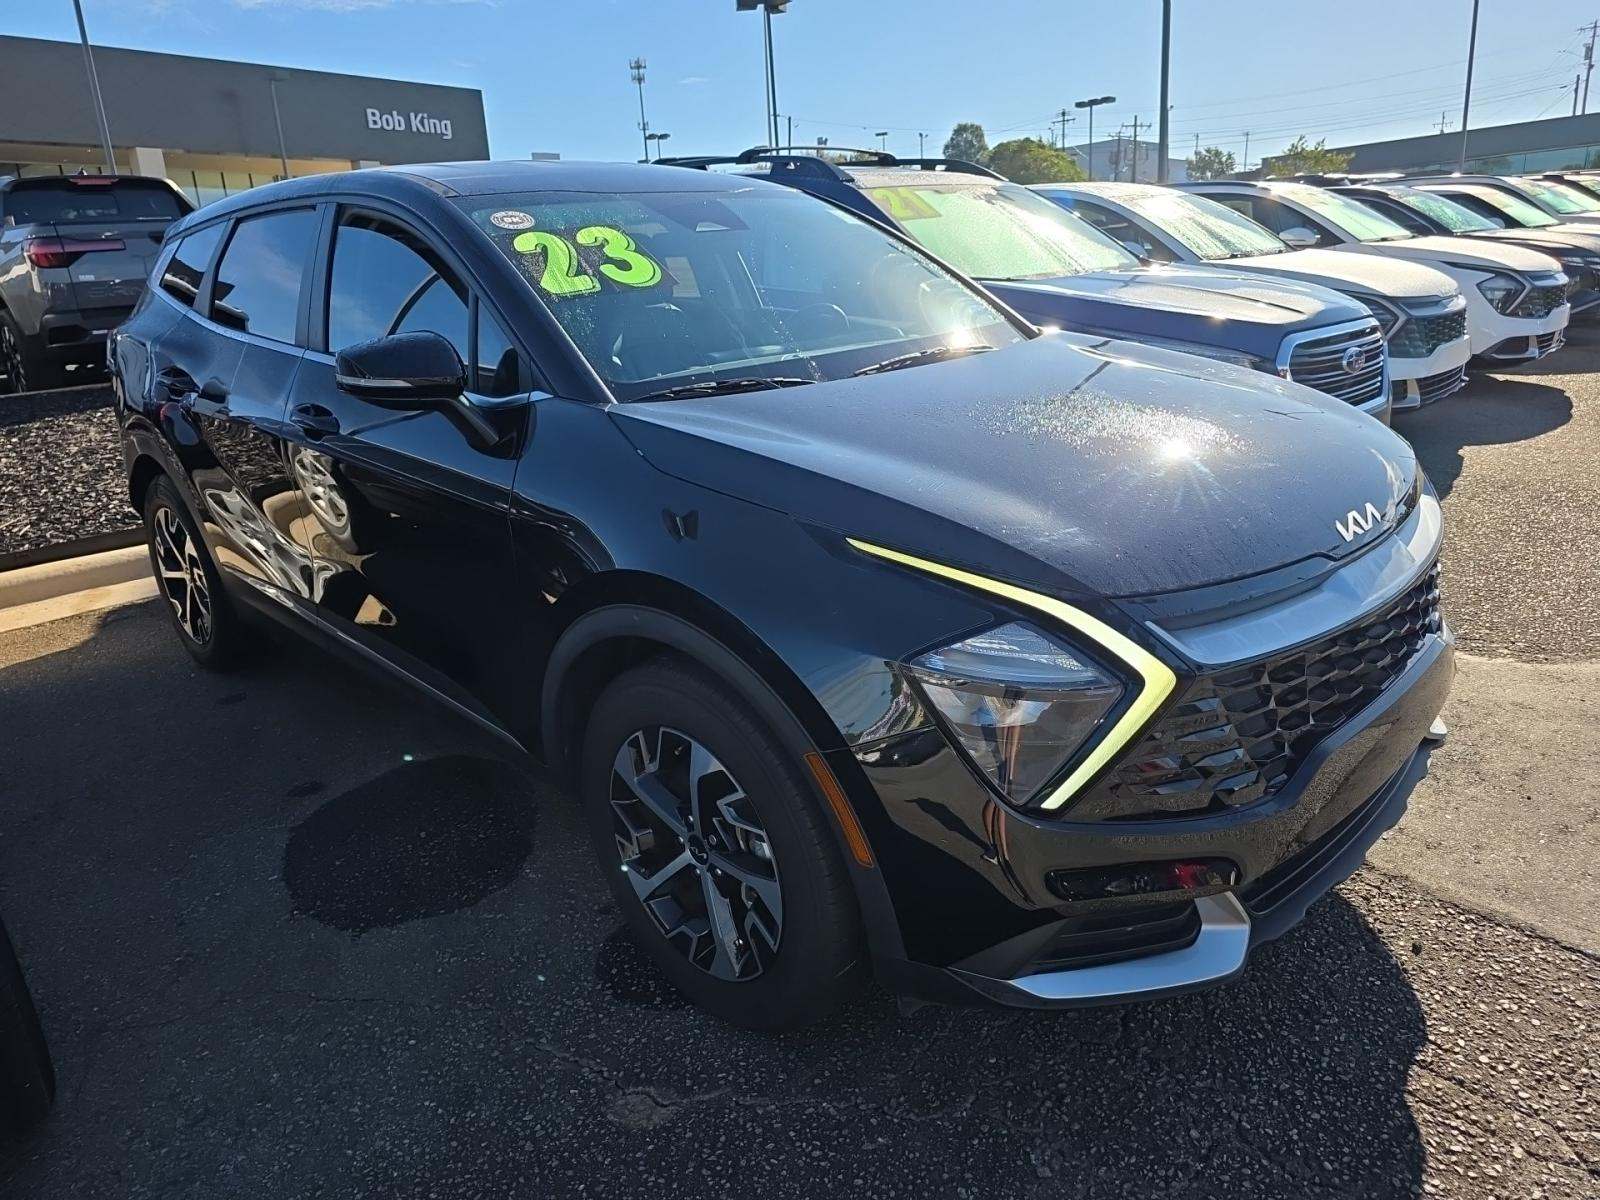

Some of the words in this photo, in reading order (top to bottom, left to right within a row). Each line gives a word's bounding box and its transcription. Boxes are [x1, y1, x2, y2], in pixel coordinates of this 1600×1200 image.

[366, 107, 406, 131] Bob
[409, 112, 453, 139] King
[513, 226, 662, 296] 23
[1335, 502, 1381, 542] KIA
